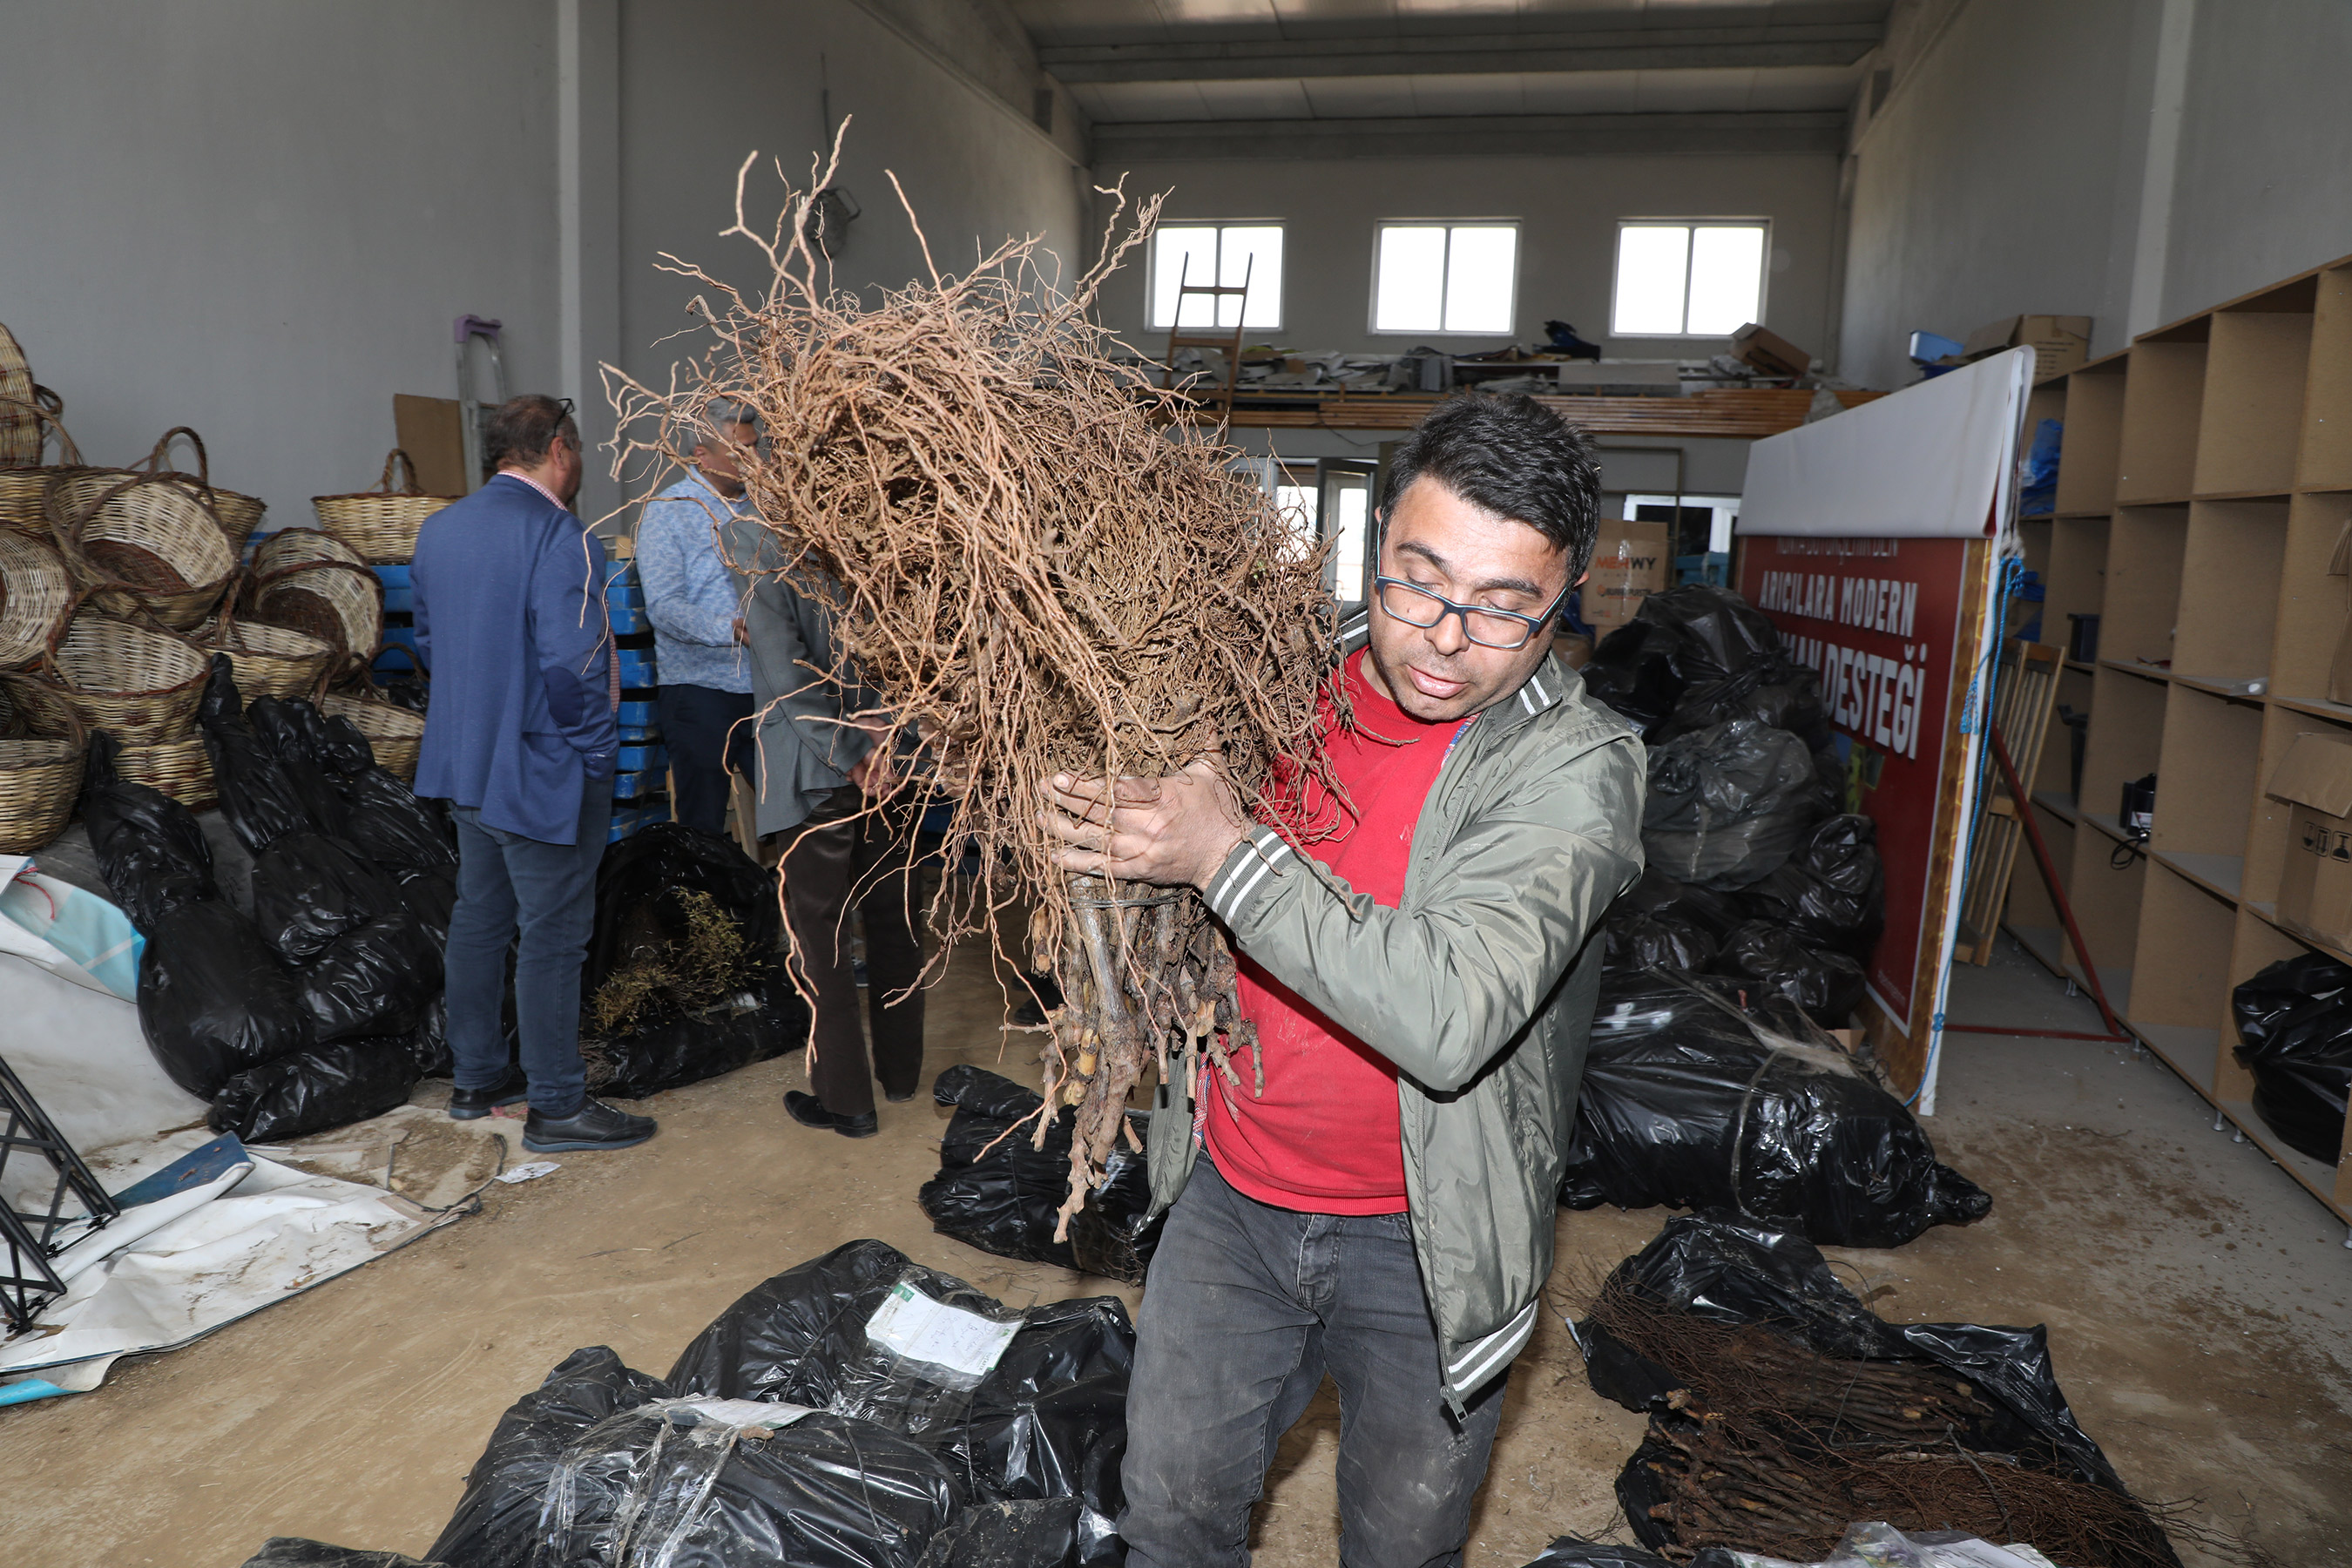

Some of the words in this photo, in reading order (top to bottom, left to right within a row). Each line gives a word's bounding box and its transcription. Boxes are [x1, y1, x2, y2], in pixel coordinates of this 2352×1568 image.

[1758, 571, 1835, 621] ARICILARA
[1840, 577, 1918, 638] MODERN
[1822, 642, 1927, 760] DESTEĞİ
